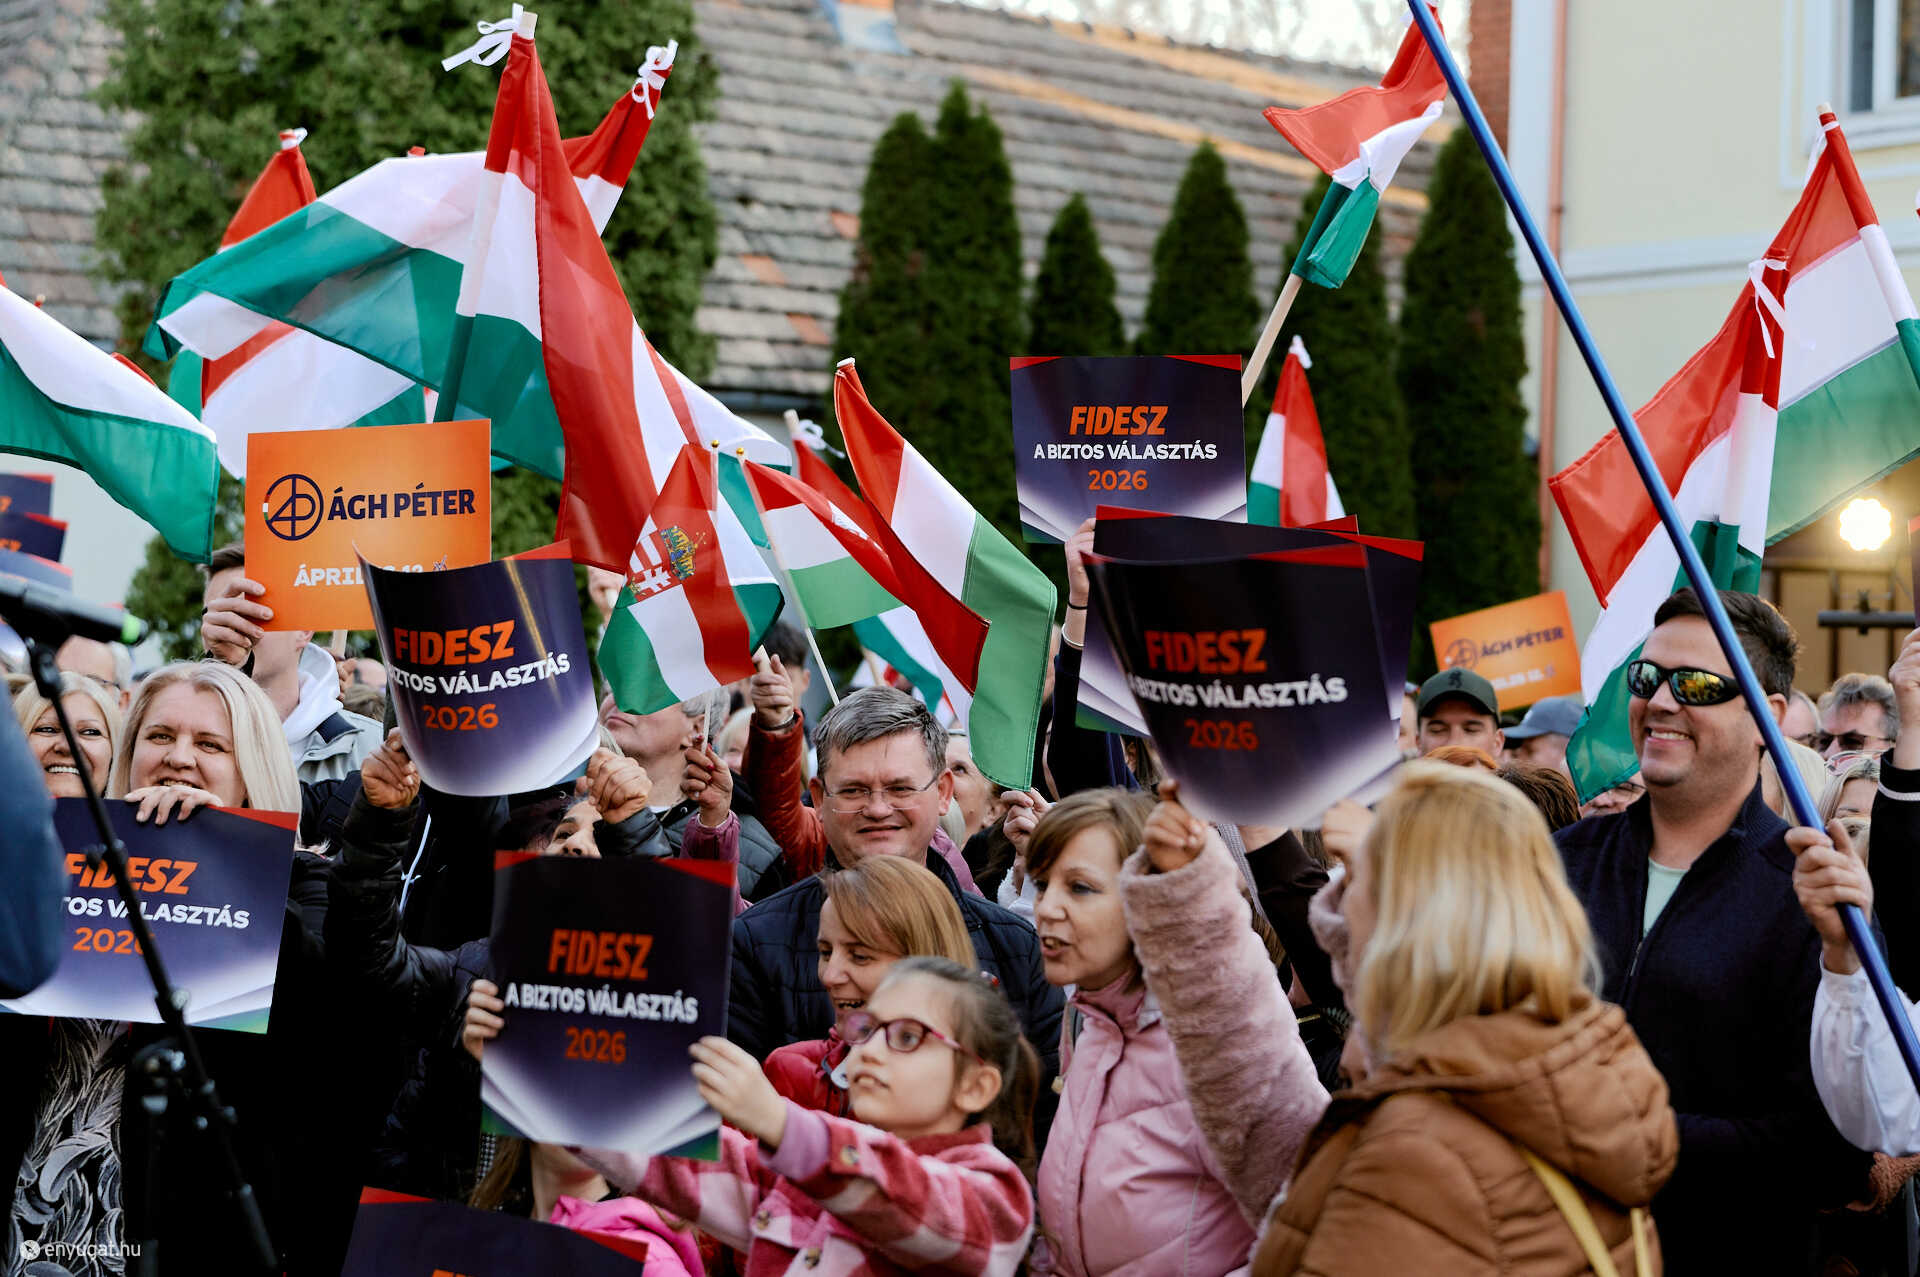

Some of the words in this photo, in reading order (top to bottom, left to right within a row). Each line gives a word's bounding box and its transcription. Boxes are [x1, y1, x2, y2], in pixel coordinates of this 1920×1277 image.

[1069, 405, 1169, 436] FIDESZ
[1033, 444, 1046, 460] A
[1047, 443, 1105, 460] BIZTOS
[1106, 440, 1218, 460] VÁLASZTÁS
[1087, 469, 1149, 491] 2026
[327, 486, 388, 521] ÁGH
[393, 482, 476, 518] PÉTER
[294, 563, 396, 587] ÁPRIL
[393, 619, 516, 666] FIDESZ
[1144, 628, 1268, 675] FIDESZ
[439, 652, 571, 695] VÁLASZTÁS
[1197, 673, 1348, 709] VÁLASZTÁS
[422, 703, 499, 731] 2026
[1184, 717, 1260, 751] 2026
[547, 928, 654, 980] FIDESZ
[505, 981, 520, 1008] A
[520, 982, 587, 1014] BIZTOS
[587, 983, 699, 1024] VÁLASZTÁS
[564, 1026, 627, 1064] 2026
